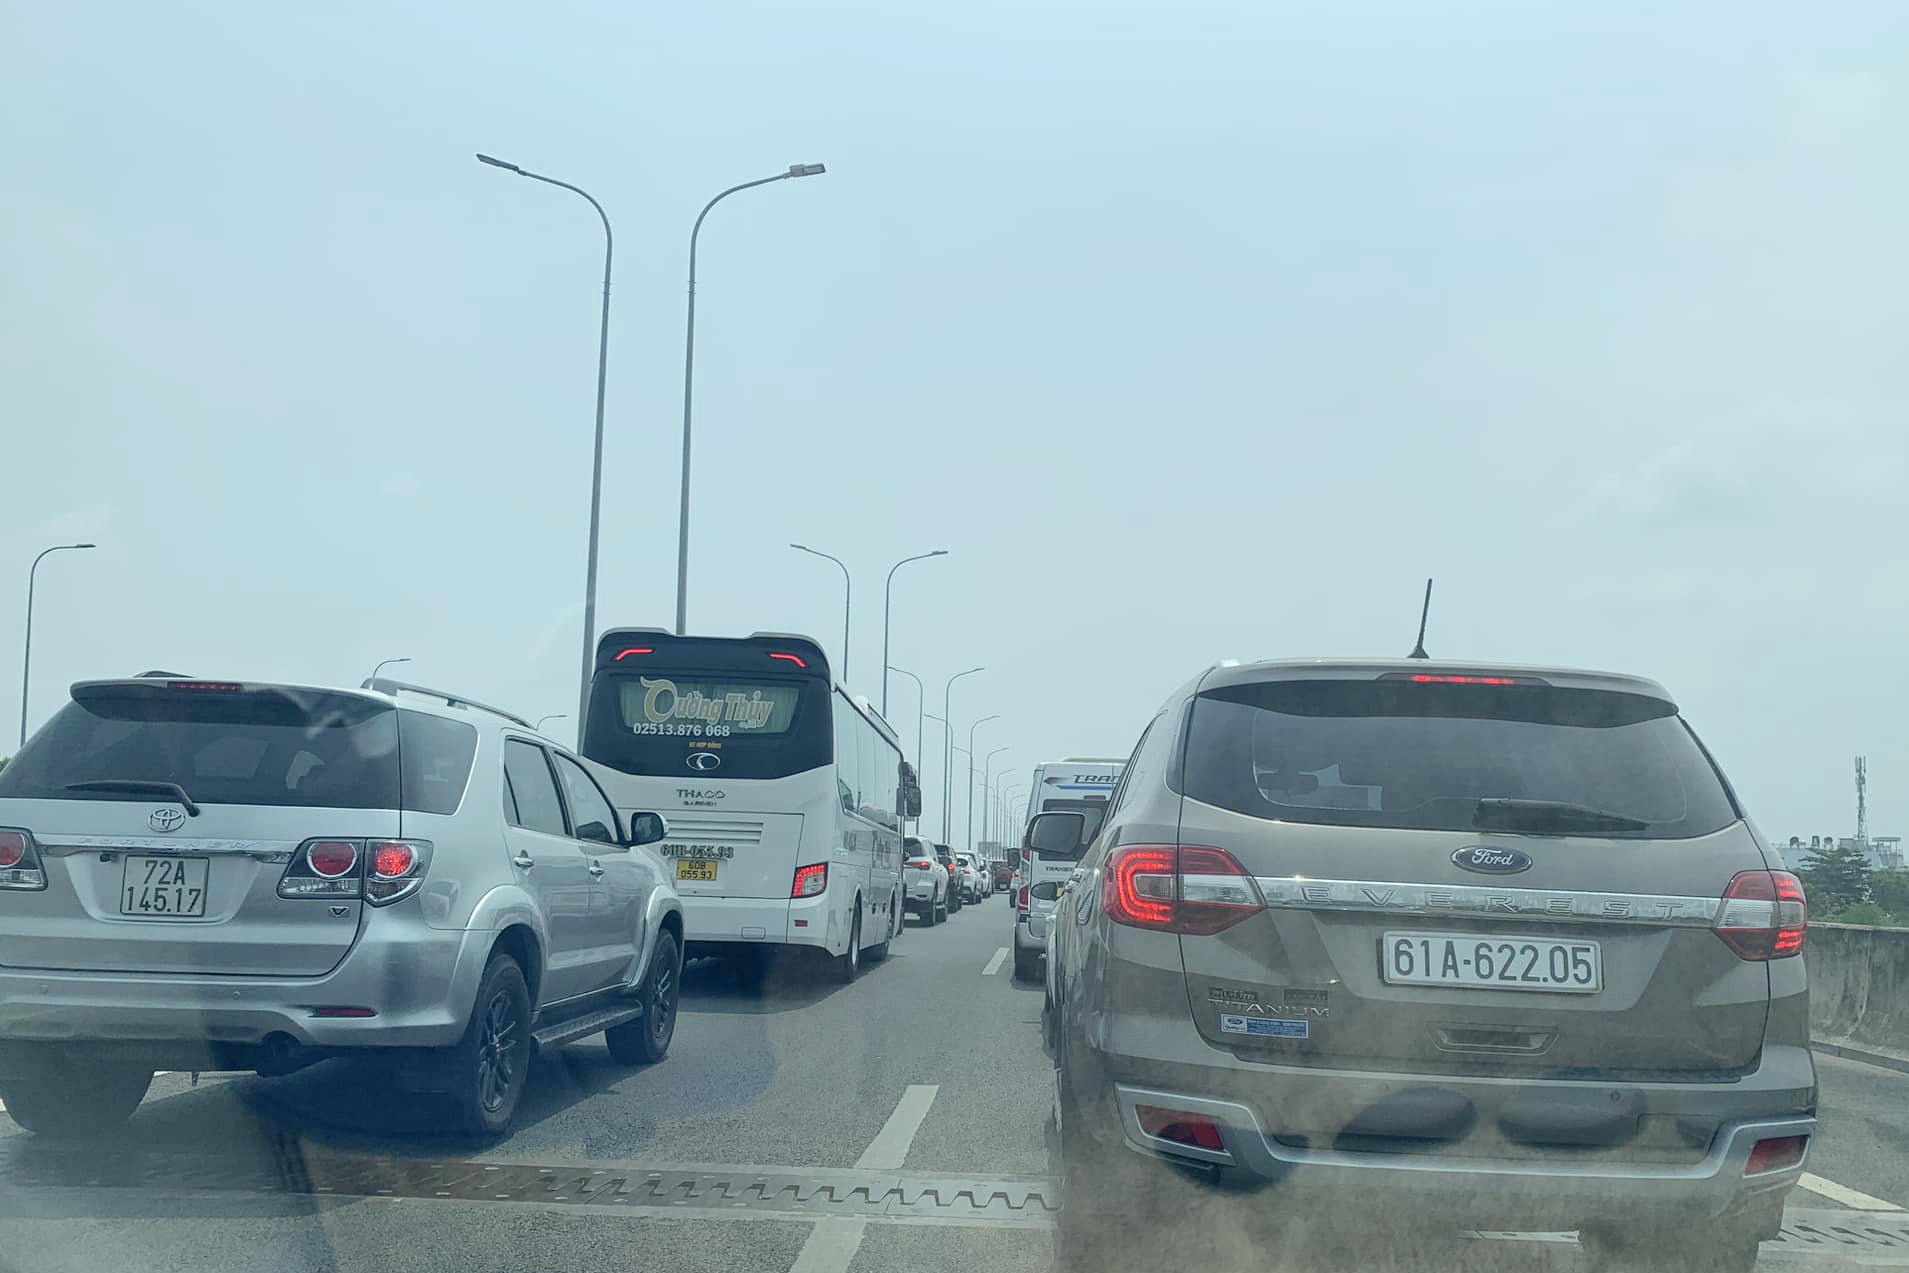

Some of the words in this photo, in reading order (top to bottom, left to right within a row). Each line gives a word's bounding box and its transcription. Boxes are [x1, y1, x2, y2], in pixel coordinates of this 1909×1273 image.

[633, 722, 702, 736] 02513.876
[705, 725, 730, 737] 068
[676, 789, 726, 799] THACO
[688, 861, 706, 869] 60B
[1471, 848, 1514, 866] Ford
[144, 860, 185, 885] 72A
[127, 886, 201, 913] 145.17
[1301, 886, 1684, 919] EVEREST
[1394, 938, 1593, 985] 61A-622.05
[1207, 998, 1329, 1017] TITANIUM
